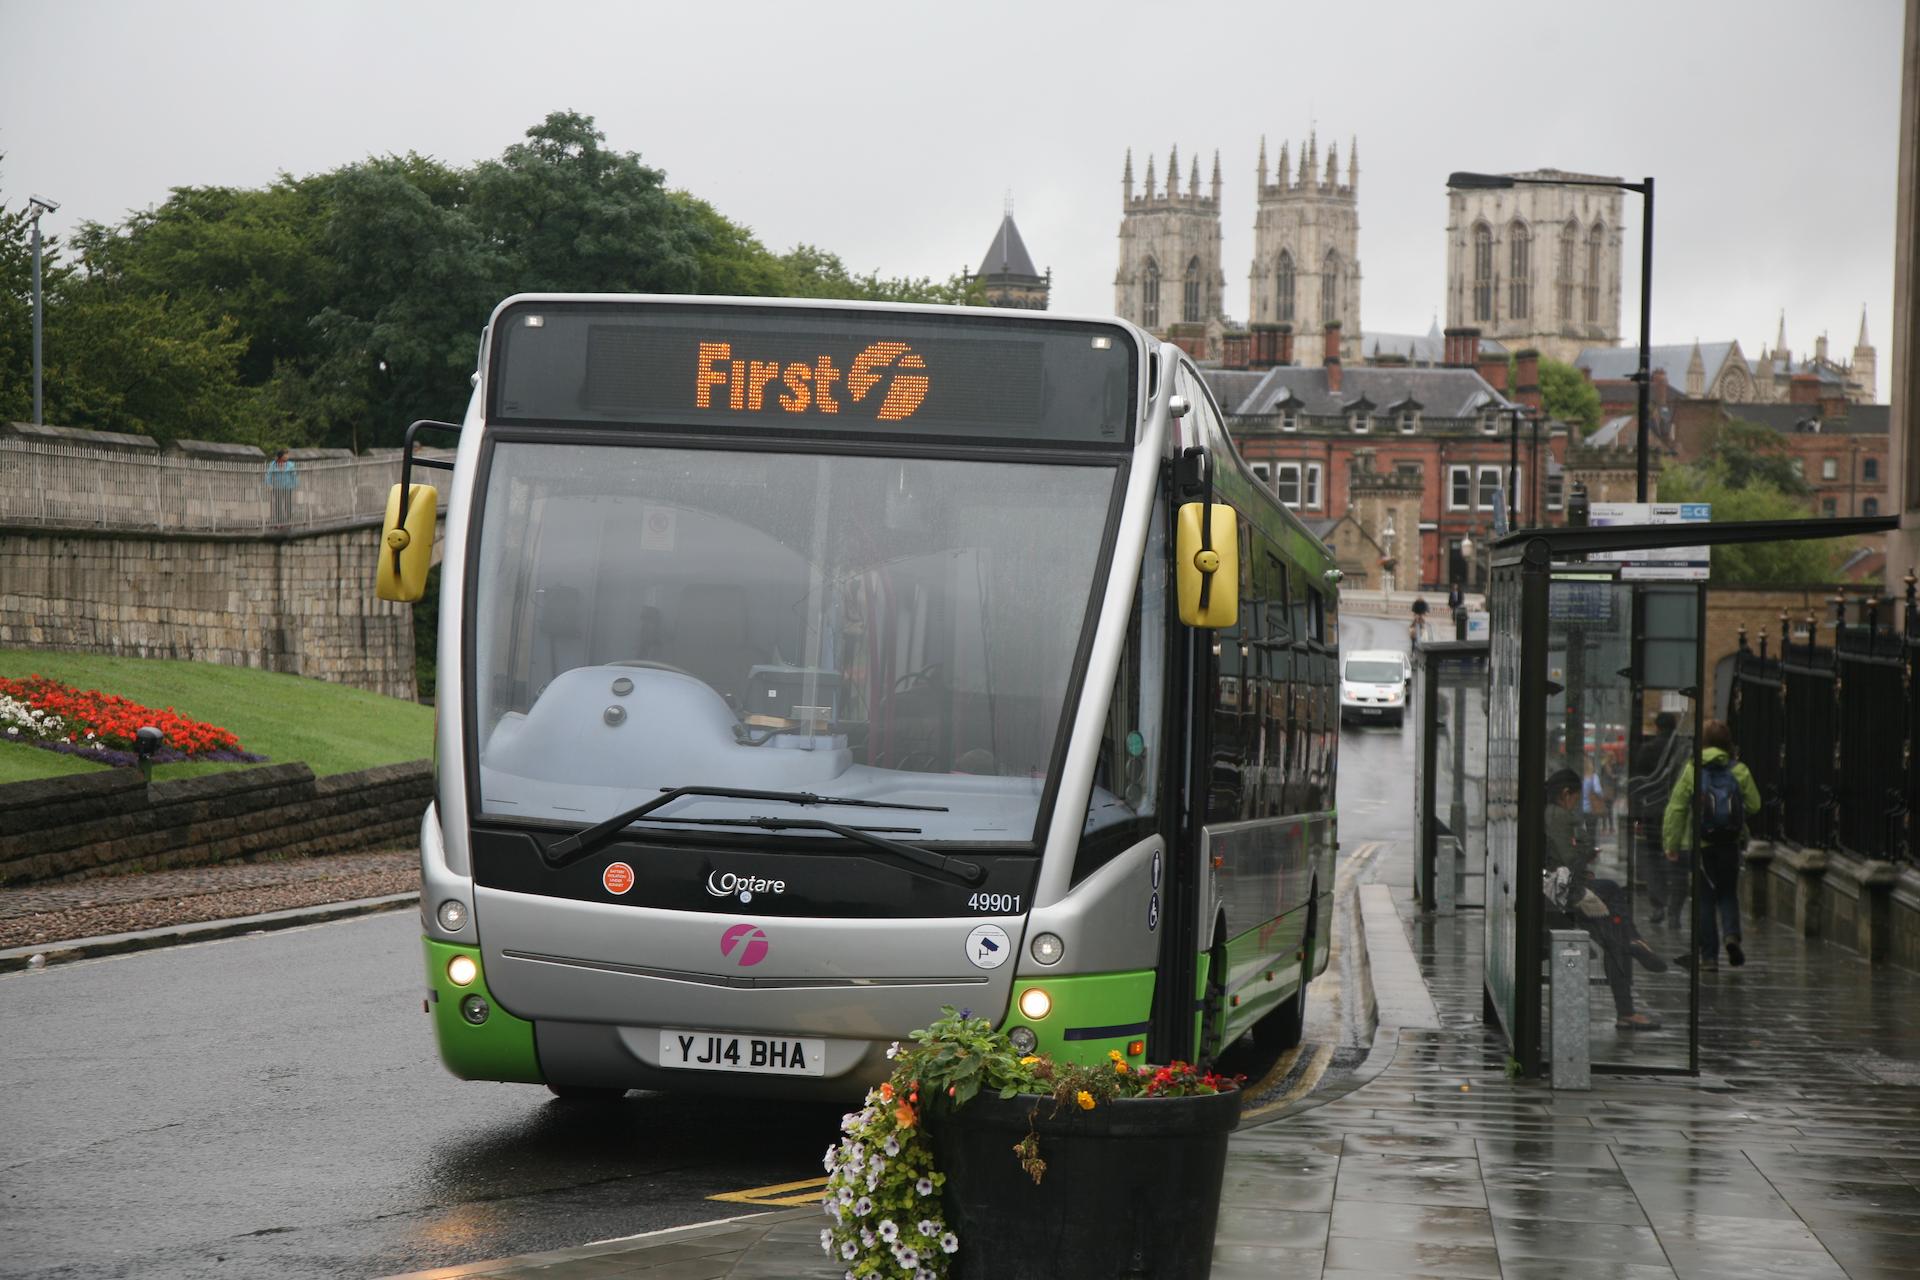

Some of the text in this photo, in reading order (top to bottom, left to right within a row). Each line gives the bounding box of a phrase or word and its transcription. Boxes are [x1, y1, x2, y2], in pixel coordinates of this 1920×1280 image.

[697, 342, 840, 413] First
[1693, 507, 1709, 517] CE
[720, 872, 786, 896] Optare
[968, 893, 1020, 912] 49901
[678, 1035, 806, 1069] YJ14 BHA
